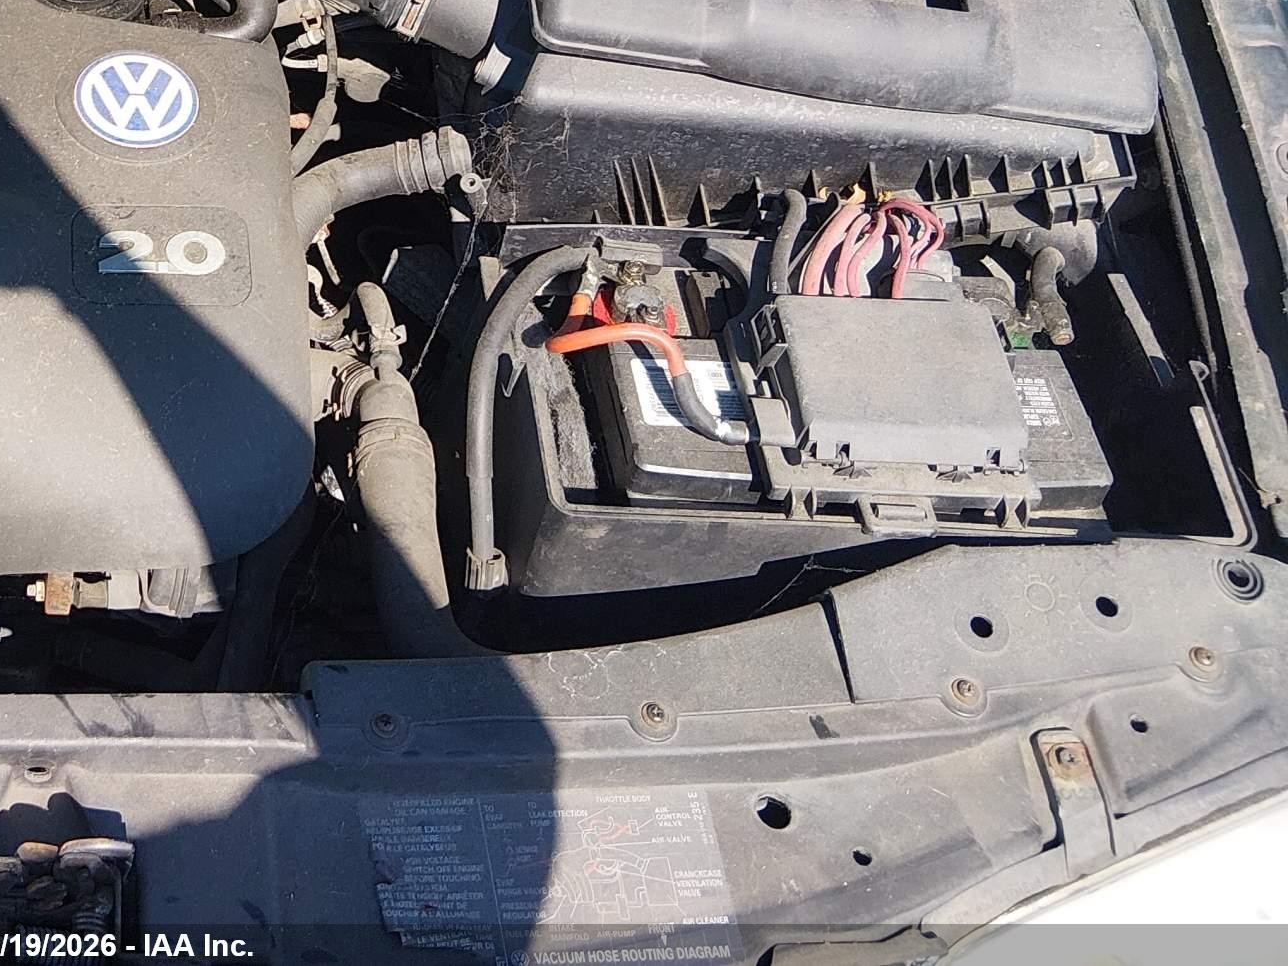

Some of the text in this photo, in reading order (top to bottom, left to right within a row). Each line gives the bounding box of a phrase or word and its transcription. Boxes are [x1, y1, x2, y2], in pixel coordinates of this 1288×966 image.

[73, 48, 200, 149] VW
[675, 878, 724, 888] VENTILATION
[695, 916, 729, 925] CLEANER
[533, 950, 584, 965] VACUUM
[587, 949, 620, 963] HOSE
[621, 947, 674, 962] ROUTING
[676, 945, 731, 960] DIAGRAM
